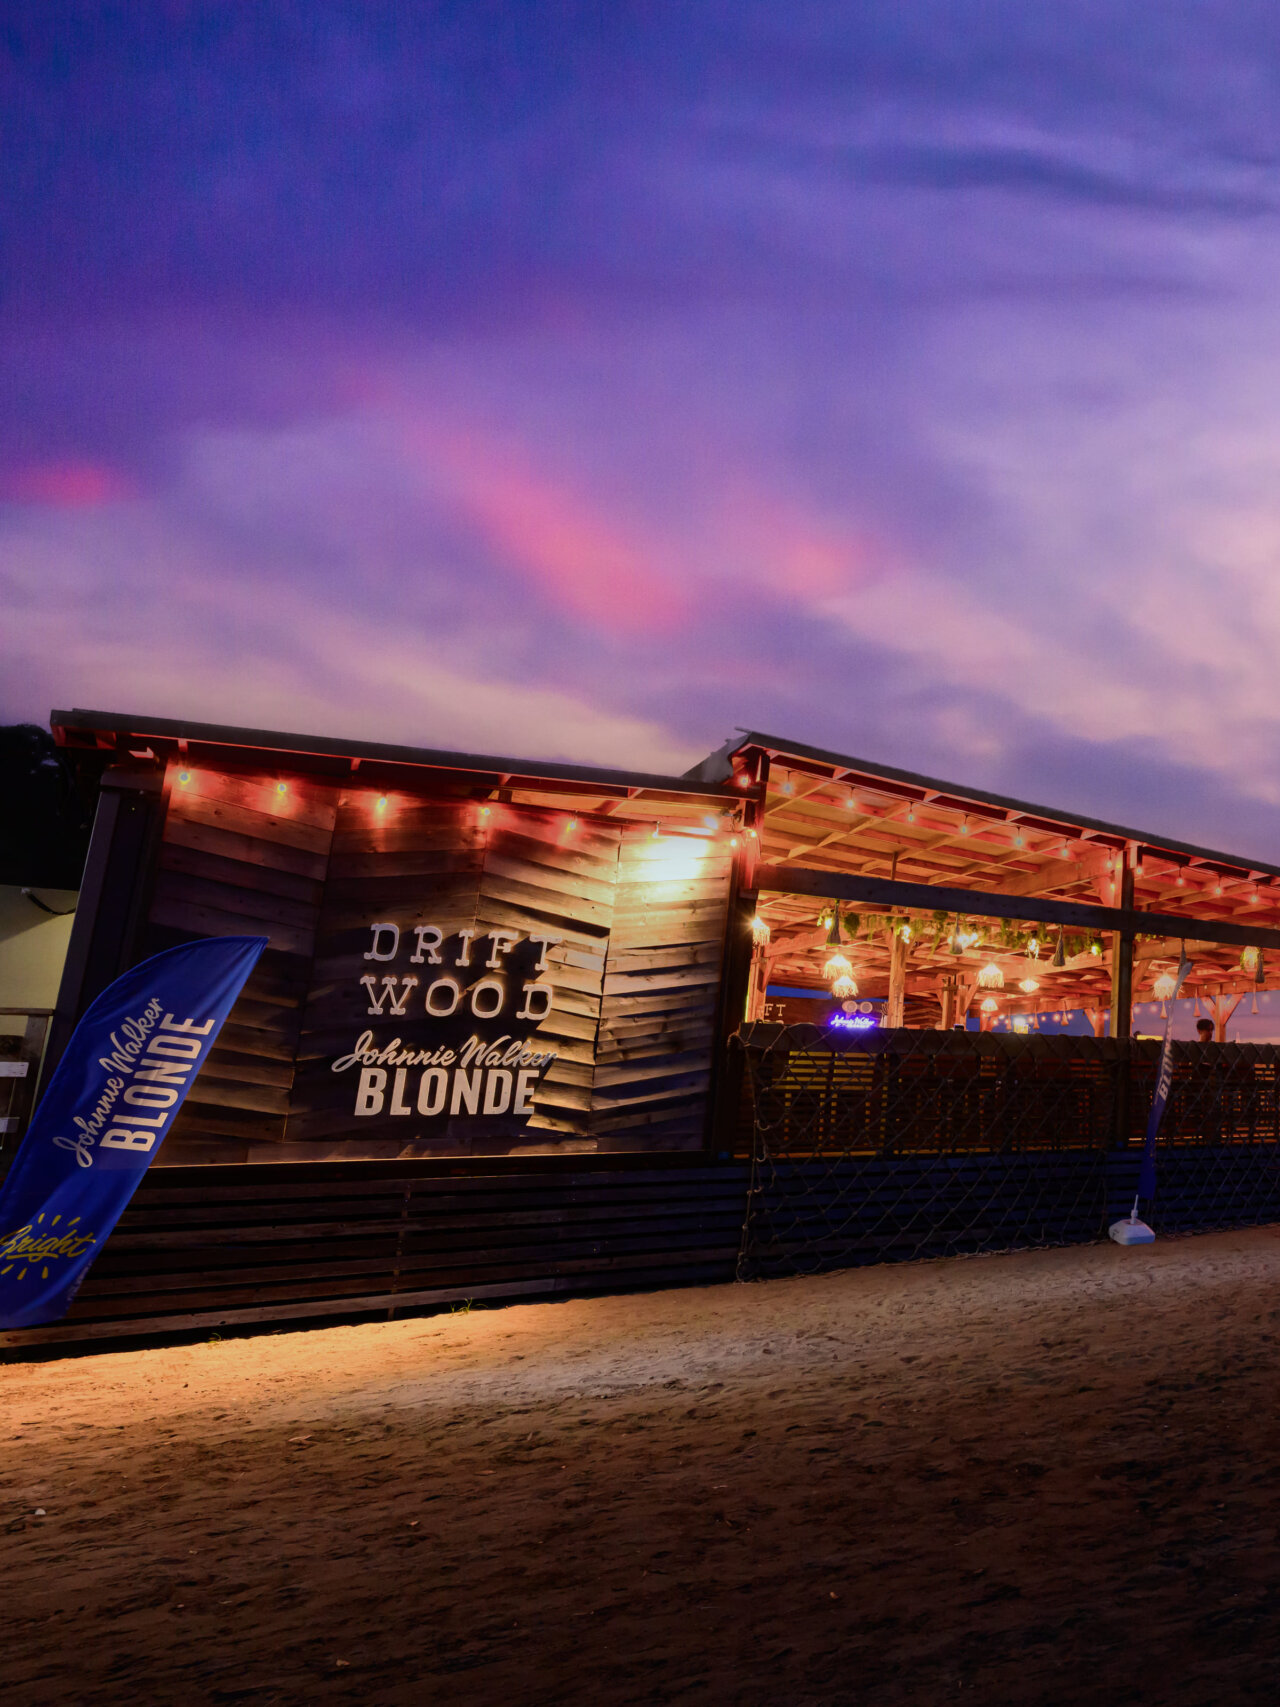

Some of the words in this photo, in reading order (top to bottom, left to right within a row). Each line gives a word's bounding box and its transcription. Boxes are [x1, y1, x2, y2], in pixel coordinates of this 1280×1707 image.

[364, 923, 563, 972] DRIFT
[360, 975, 553, 1021] WOOD
[331, 1030, 457, 1073] Johnnie
[460, 1035, 559, 1069] Walker
[52, 1076, 125, 1168] Johnnie
[99, 998, 161, 1074] Walker
[99, 1013, 216, 1152] BLONDE
[354, 1067, 541, 1117] BLONDE
[0, 1225, 97, 1263] Bright
